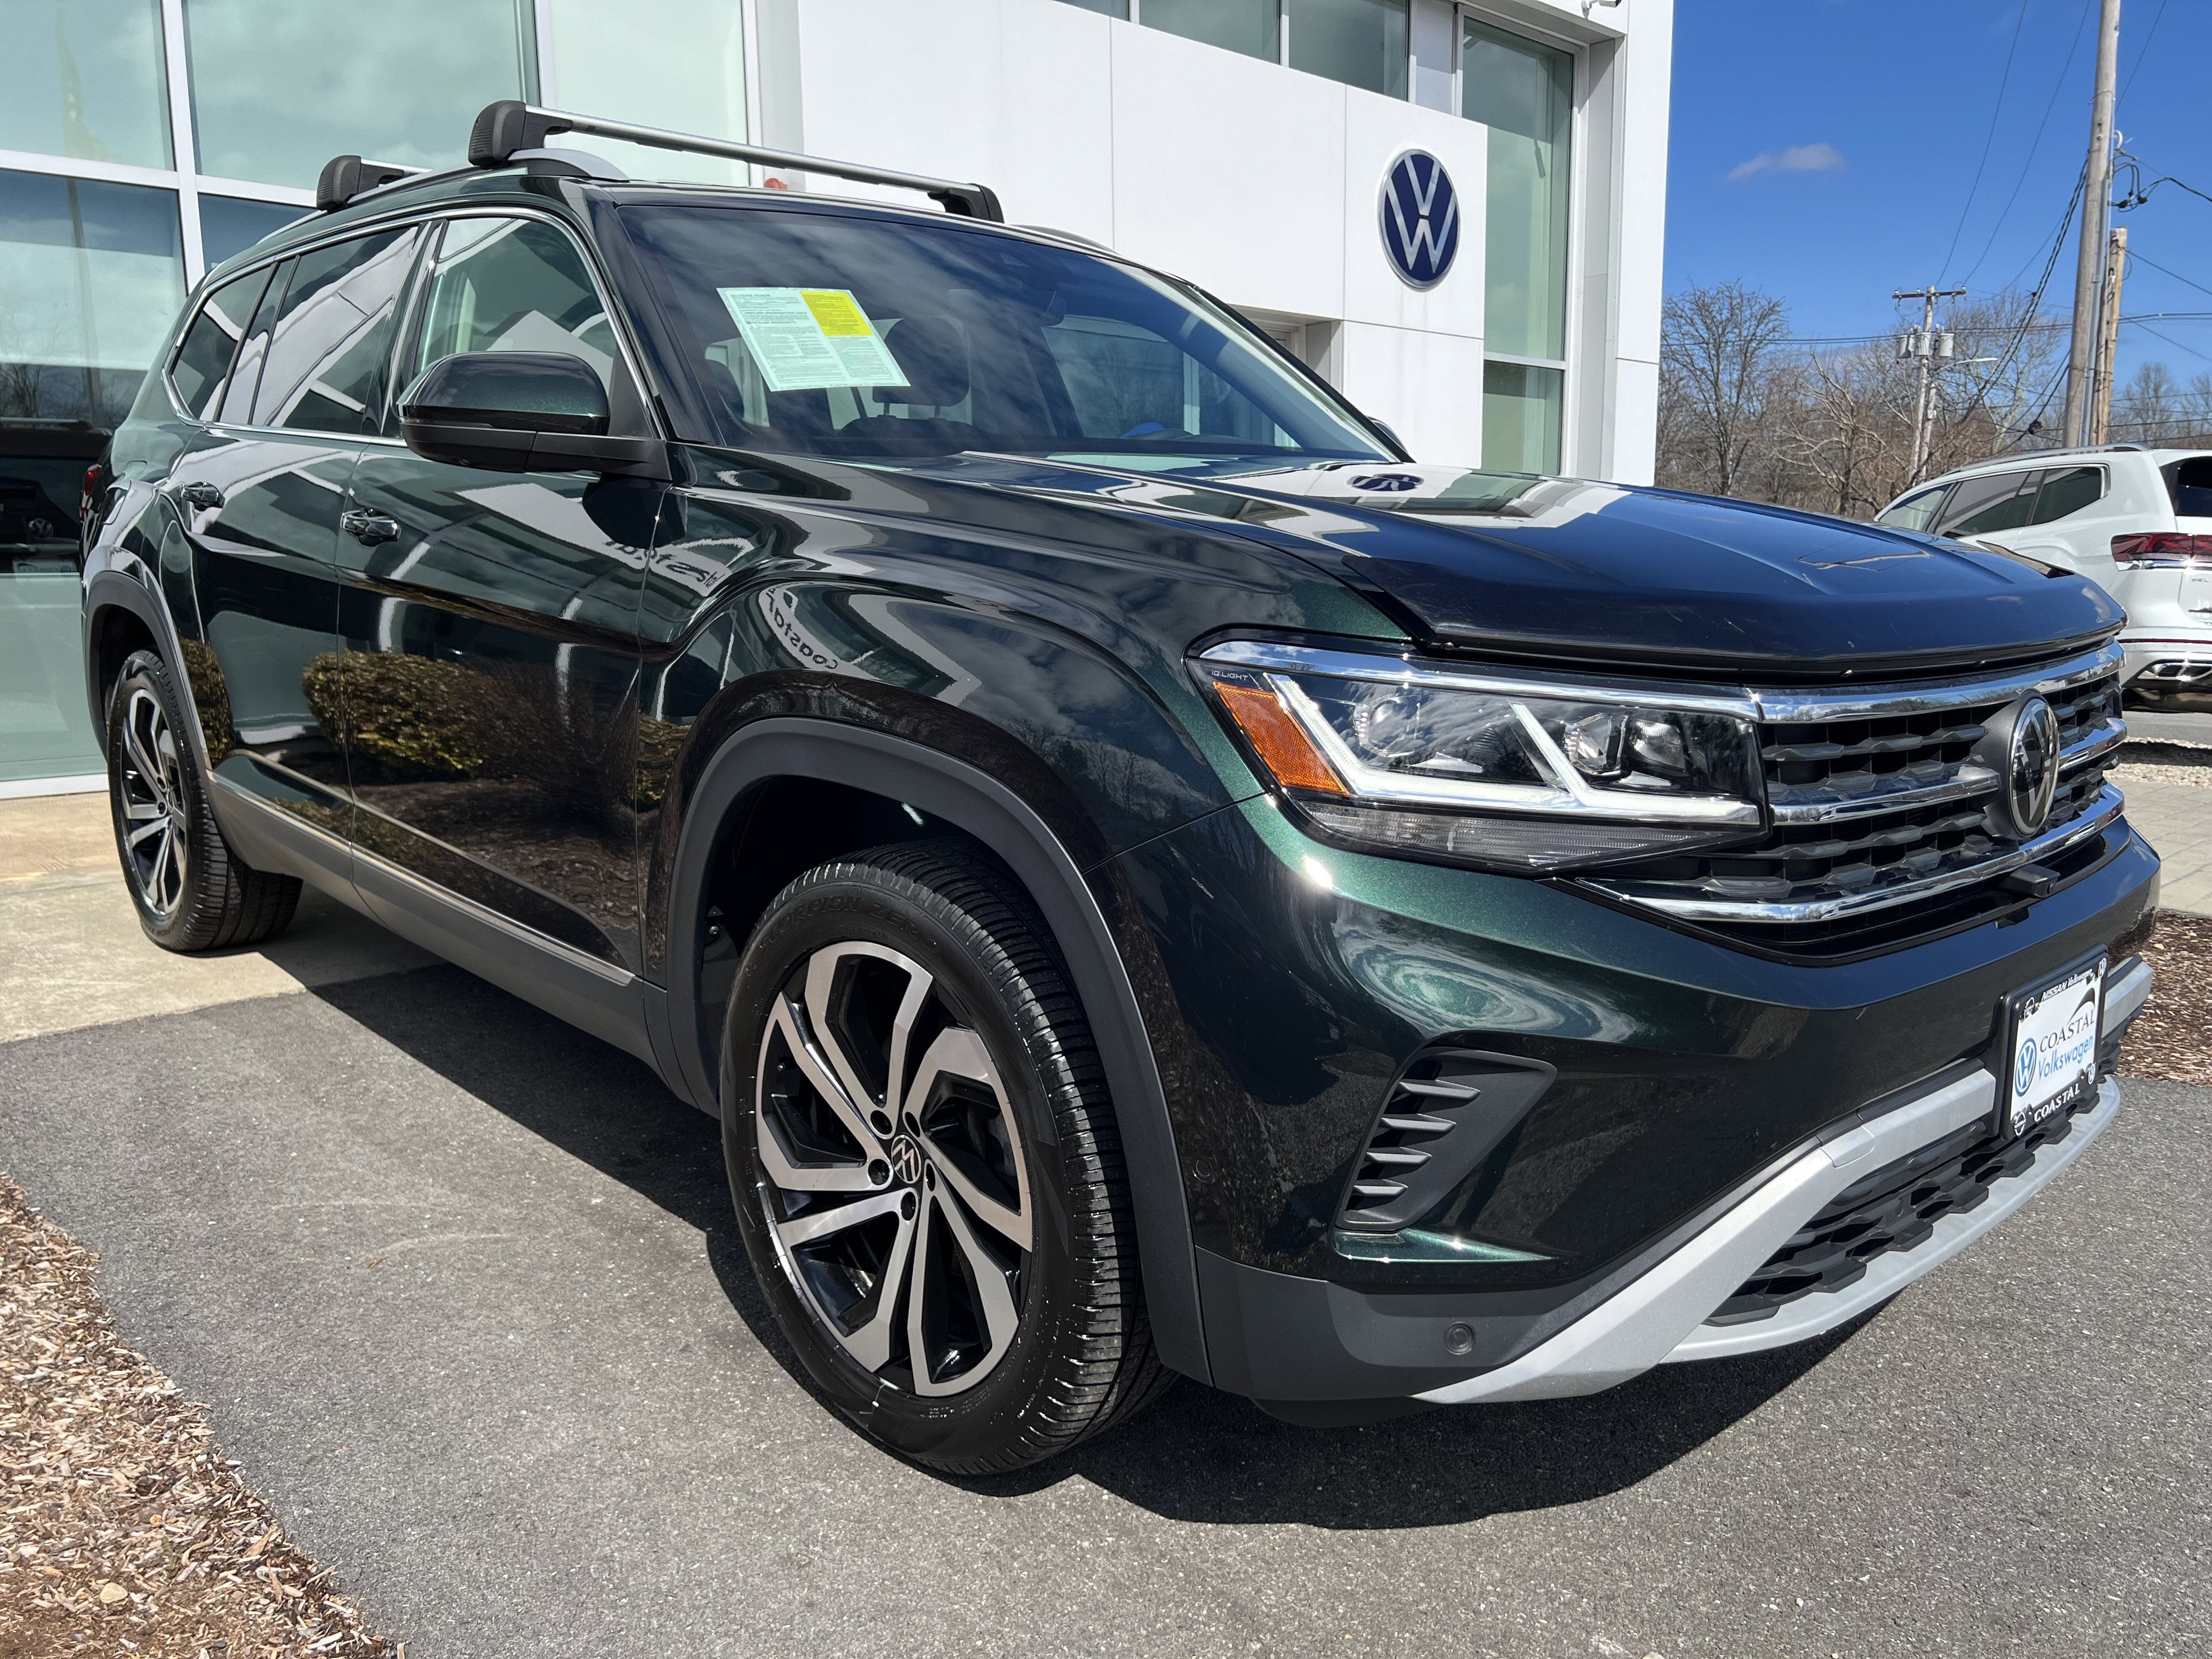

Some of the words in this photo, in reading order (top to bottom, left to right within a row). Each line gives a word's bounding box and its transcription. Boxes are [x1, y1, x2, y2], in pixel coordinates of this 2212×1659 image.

[1211, 670, 1249, 681] IQ.LIGHT
[2041, 980, 2068, 1002] NISSAN
[2040, 1009, 2095, 1053] COASTAL
[2038, 1035, 2093, 1081] Volkswagen
[2034, 1083, 2080, 1122] COASTAL
